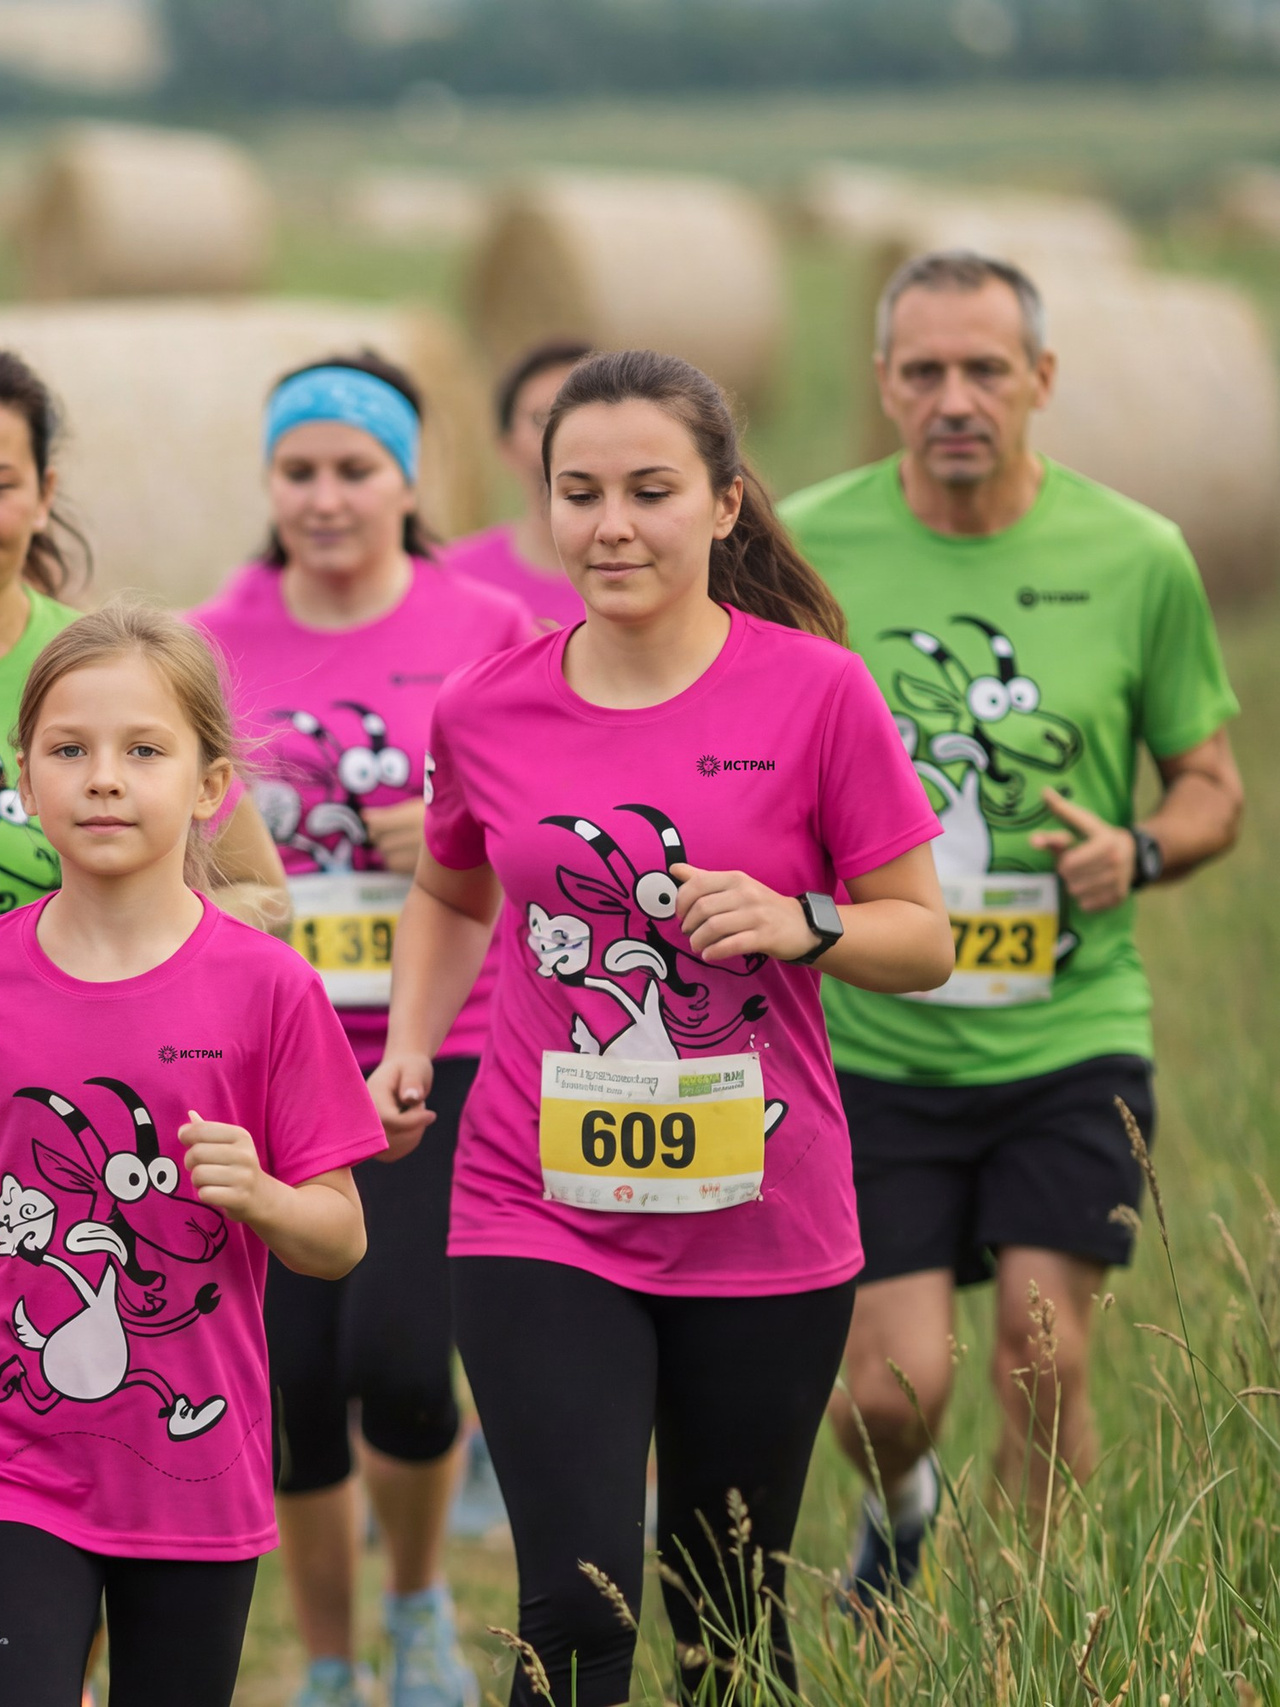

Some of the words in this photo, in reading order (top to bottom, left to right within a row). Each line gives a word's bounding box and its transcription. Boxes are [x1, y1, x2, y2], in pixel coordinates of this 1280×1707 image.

[723, 760, 775, 771] ИСТРАН
[949, 919, 1037, 967] 723
[179, 1049, 223, 1059] ИСТРАН
[581, 1109, 696, 1170] 609
